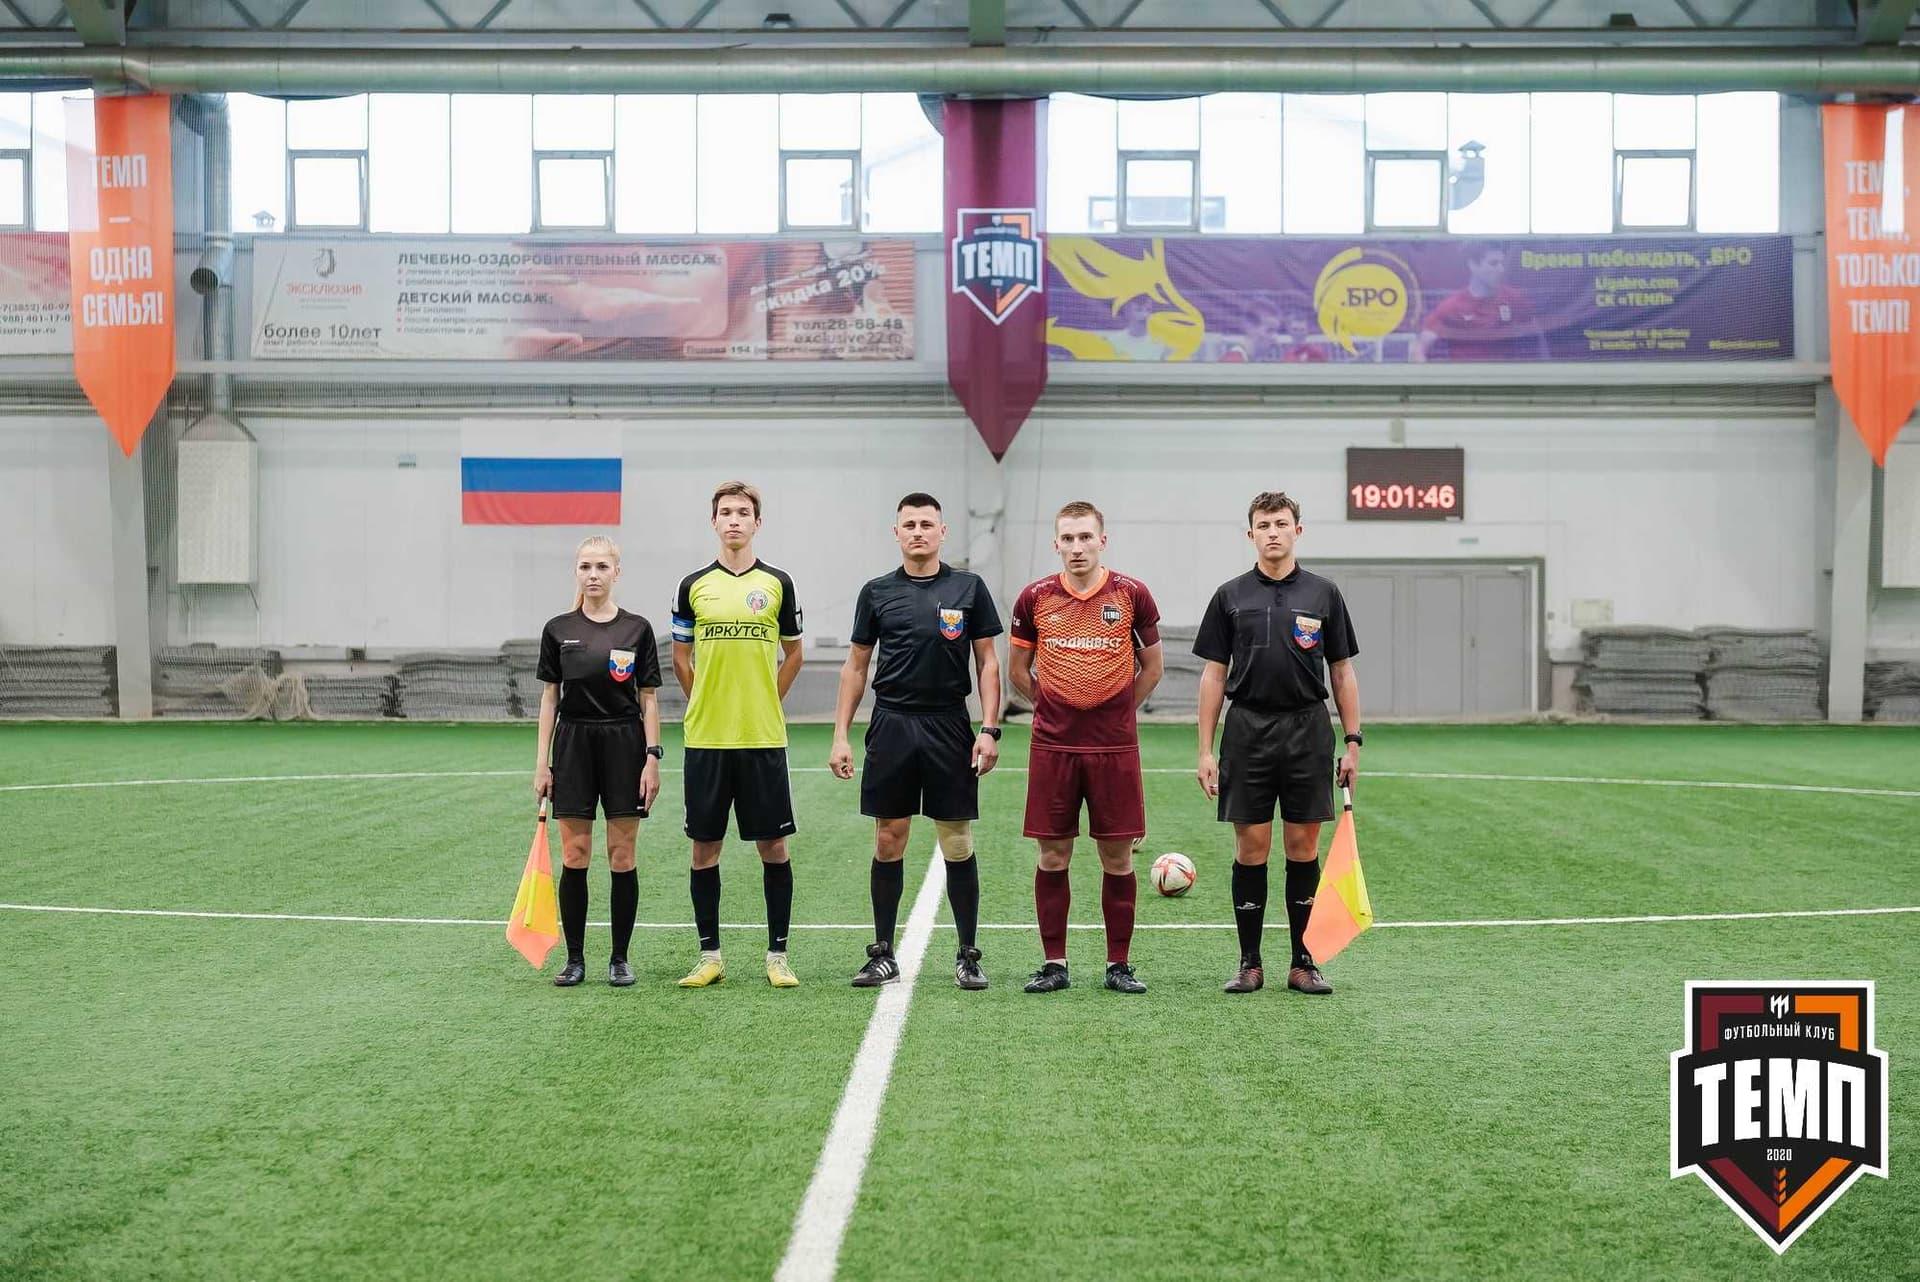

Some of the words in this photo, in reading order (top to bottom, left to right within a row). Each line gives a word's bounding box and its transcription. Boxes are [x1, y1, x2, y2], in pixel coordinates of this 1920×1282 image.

[89, 153, 147, 188] ТЕМП
[1844, 161, 1911, 200] ТЕМ,
[1844, 208, 1911, 245] ТЕМ,
[90, 246, 153, 285] ОДНА
[398, 251, 641, 267] ЛЕЧЕБНО-ОЗДОРОВИТЕЛЬНЫЙ
[646, 253, 722, 266] МАССАЖ:
[961, 241, 1034, 280] ТЕМП
[1521, 250, 1583, 269] Время
[1836, 254, 1920, 288] ТОЛЬКО
[397, 290, 473, 304] ДЕТСКИЙ
[477, 292, 554, 305] МАССАЖ:
[754, 279, 833, 313] скидка
[836, 260, 888, 290] 20%
[1341, 287, 1399, 307] .БРО
[82, 291, 164, 327] СЕМЬЯ!
[1848, 299, 1910, 334] ТЕМП!
[264, 323, 321, 339] более
[328, 323, 382, 339] 10лет
[1352, 484, 1456, 508] 19:01:46
[705, 624, 769, 639] ИРКУТСК
